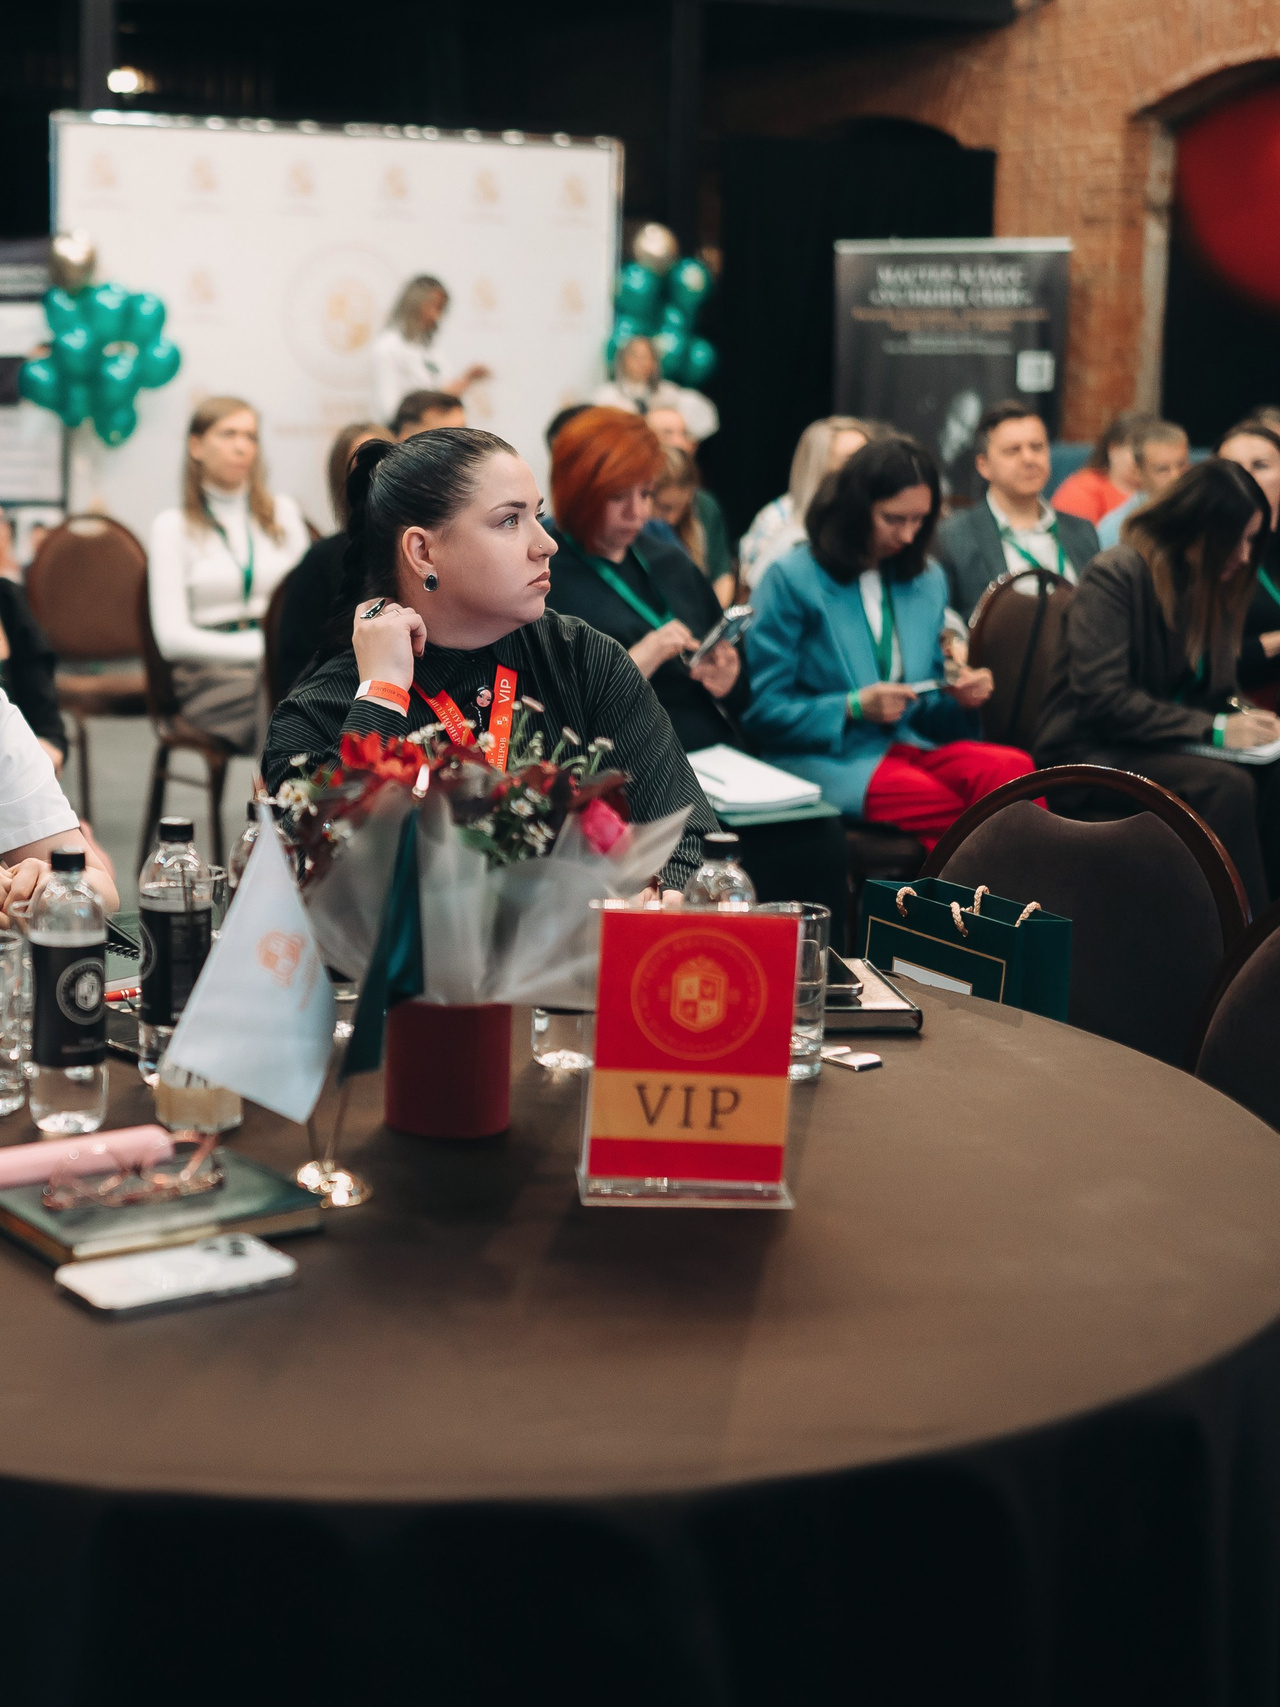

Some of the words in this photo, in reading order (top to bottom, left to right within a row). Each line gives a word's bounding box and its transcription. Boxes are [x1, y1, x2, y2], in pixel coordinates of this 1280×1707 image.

[498, 679, 511, 703] VIP
[447, 706, 464, 729] КЛУБ
[634, 1083, 741, 1130] VIP
